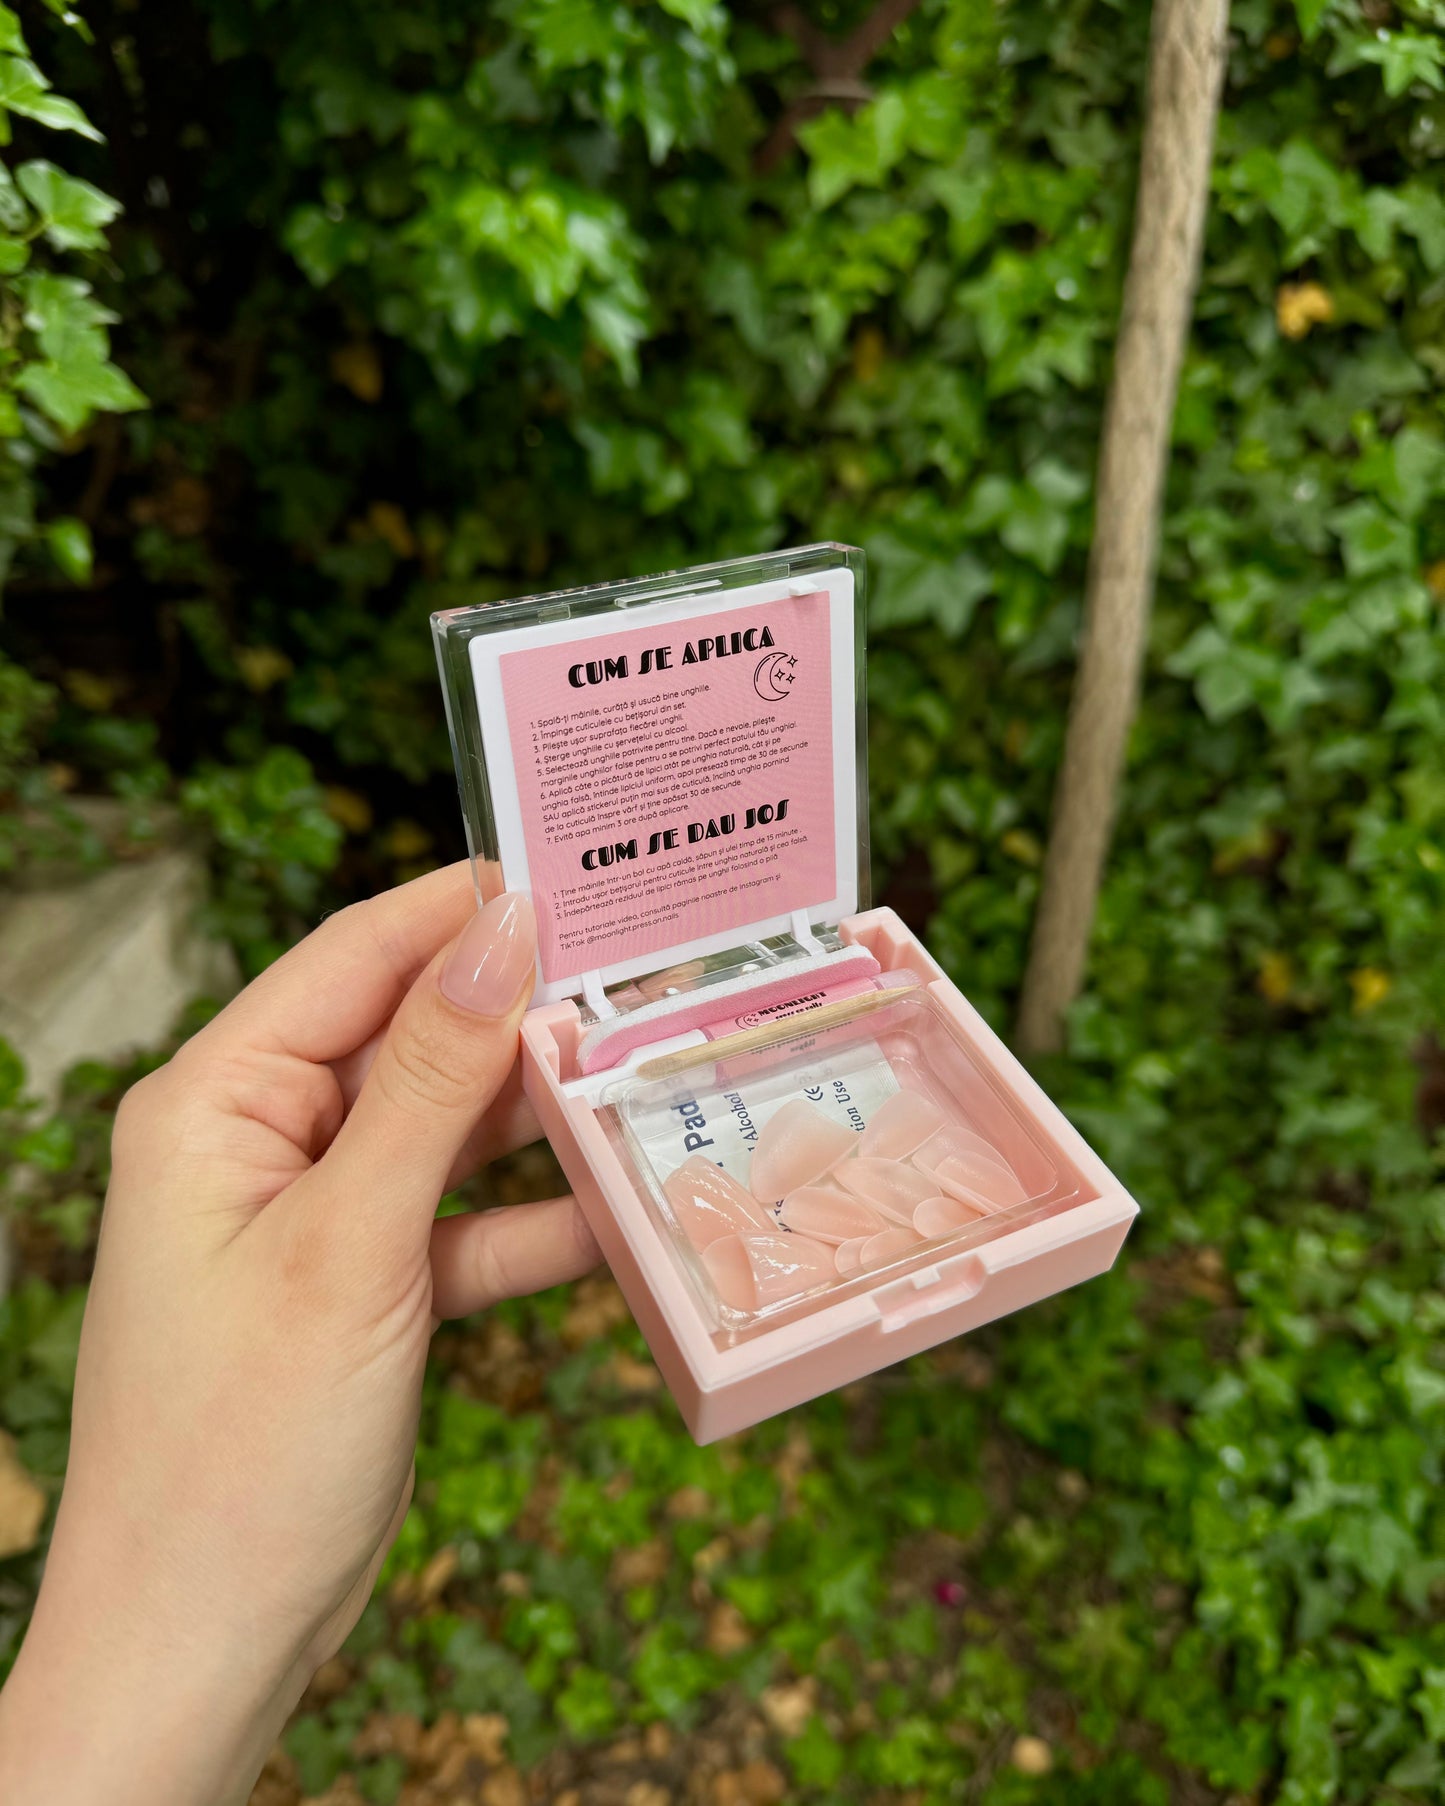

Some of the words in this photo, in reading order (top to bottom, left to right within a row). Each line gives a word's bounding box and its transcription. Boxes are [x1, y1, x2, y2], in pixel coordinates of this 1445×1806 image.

[568, 655, 629, 688] CUM
[638, 645, 673, 675] SE
[682, 626, 775, 665] APLICA
[575, 718, 612, 733] cuticulele
[613, 715, 624, 724] cu
[659, 704, 672, 714] din
[662, 690, 679, 701] bine
[541, 773, 578, 788] marginile
[580, 765, 614, 779] unghiilor
[615, 760, 634, 771] false
[635, 755, 661, 768] pentru
[667, 749, 678, 759] se
[679, 744, 703, 757] potrivi
[703, 737, 730, 751] perfect
[731, 731, 756, 745] patului
[572, 744, 603, 757] unghiile
[603, 741, 614, 750] cu
[652, 730, 664, 740] cu
[590, 752, 621, 765] unghiile
[622, 745, 654, 759] potrivite
[654, 737, 680, 752] pentru
[725, 722, 752, 734] nevoie,
[633, 768, 645, 778] de
[645, 764, 663, 776] lipici
[679, 758, 691, 768] pe
[692, 752, 718, 764] unghia
[770, 736, 782, 747] pe
[542, 799, 569, 812] unghia
[620, 780, 644, 793] lipiciul
[645, 774, 677, 787] uniform,
[677, 768, 694, 780] apoi
[730, 754, 747, 766] timp
[746, 750, 758, 762] de
[757, 749, 768, 759] 30
[767, 747, 779, 757] de
[779, 741, 809, 754] secunde
[543, 811, 560, 823] SAU
[587, 797, 619, 812] stickerul
[640, 788, 656, 799] mai
[656, 785, 670, 795] sus
[669, 782, 681, 792] de
[737, 763, 762, 775] unghia
[763, 755, 790, 770] pornind
[544, 824, 556, 834] de
[555, 822, 565, 831] la
[688, 788, 700, 798] 30
[699, 785, 710, 796] de
[575, 828, 591, 838] apa
[592, 822, 616, 834] minim
[623, 816, 638, 826] ore
[582, 838, 638, 871] CUM
[647, 827, 680, 855] SE
[687, 813, 736, 844] DAU
[744, 798, 789, 830] JOS
[632, 868, 645, 878] bol
[645, 866, 656, 875] cu
[725, 842, 739, 853] ulei
[739, 839, 756, 849] timp
[755, 836, 766, 845] de
[765, 832, 775, 842] 15
[775, 828, 799, 840] minute
[563, 895, 591, 908] Introdu
[643, 874, 668, 887] pentru
[668, 866, 696, 879] cuticule
[714, 854, 739, 866] unghia
[776, 840, 790, 849] cea
[615, 890, 644, 904] reziduul
[644, 887, 656, 896] de
[656, 882, 673, 893] lipici
[697, 873, 708, 883] pe
[708, 866, 730, 878] unghii
[731, 858, 759, 872] folosind
[559, 929, 584, 941] Pentru
[585, 920, 616, 934] tutoriale
[617, 913, 640, 924] video,
[672, 897, 700, 911] paginile
[701, 889, 728, 901] noastre
[727, 885, 738, 893] de
[560, 938, 586, 951] TikTok
[758, 991, 827, 1017] MOONLIGHT
[833, 1080, 852, 1104] Use
[723, 1092, 759, 1142] Alcohol
[848, 1107, 867, 1134] tion
